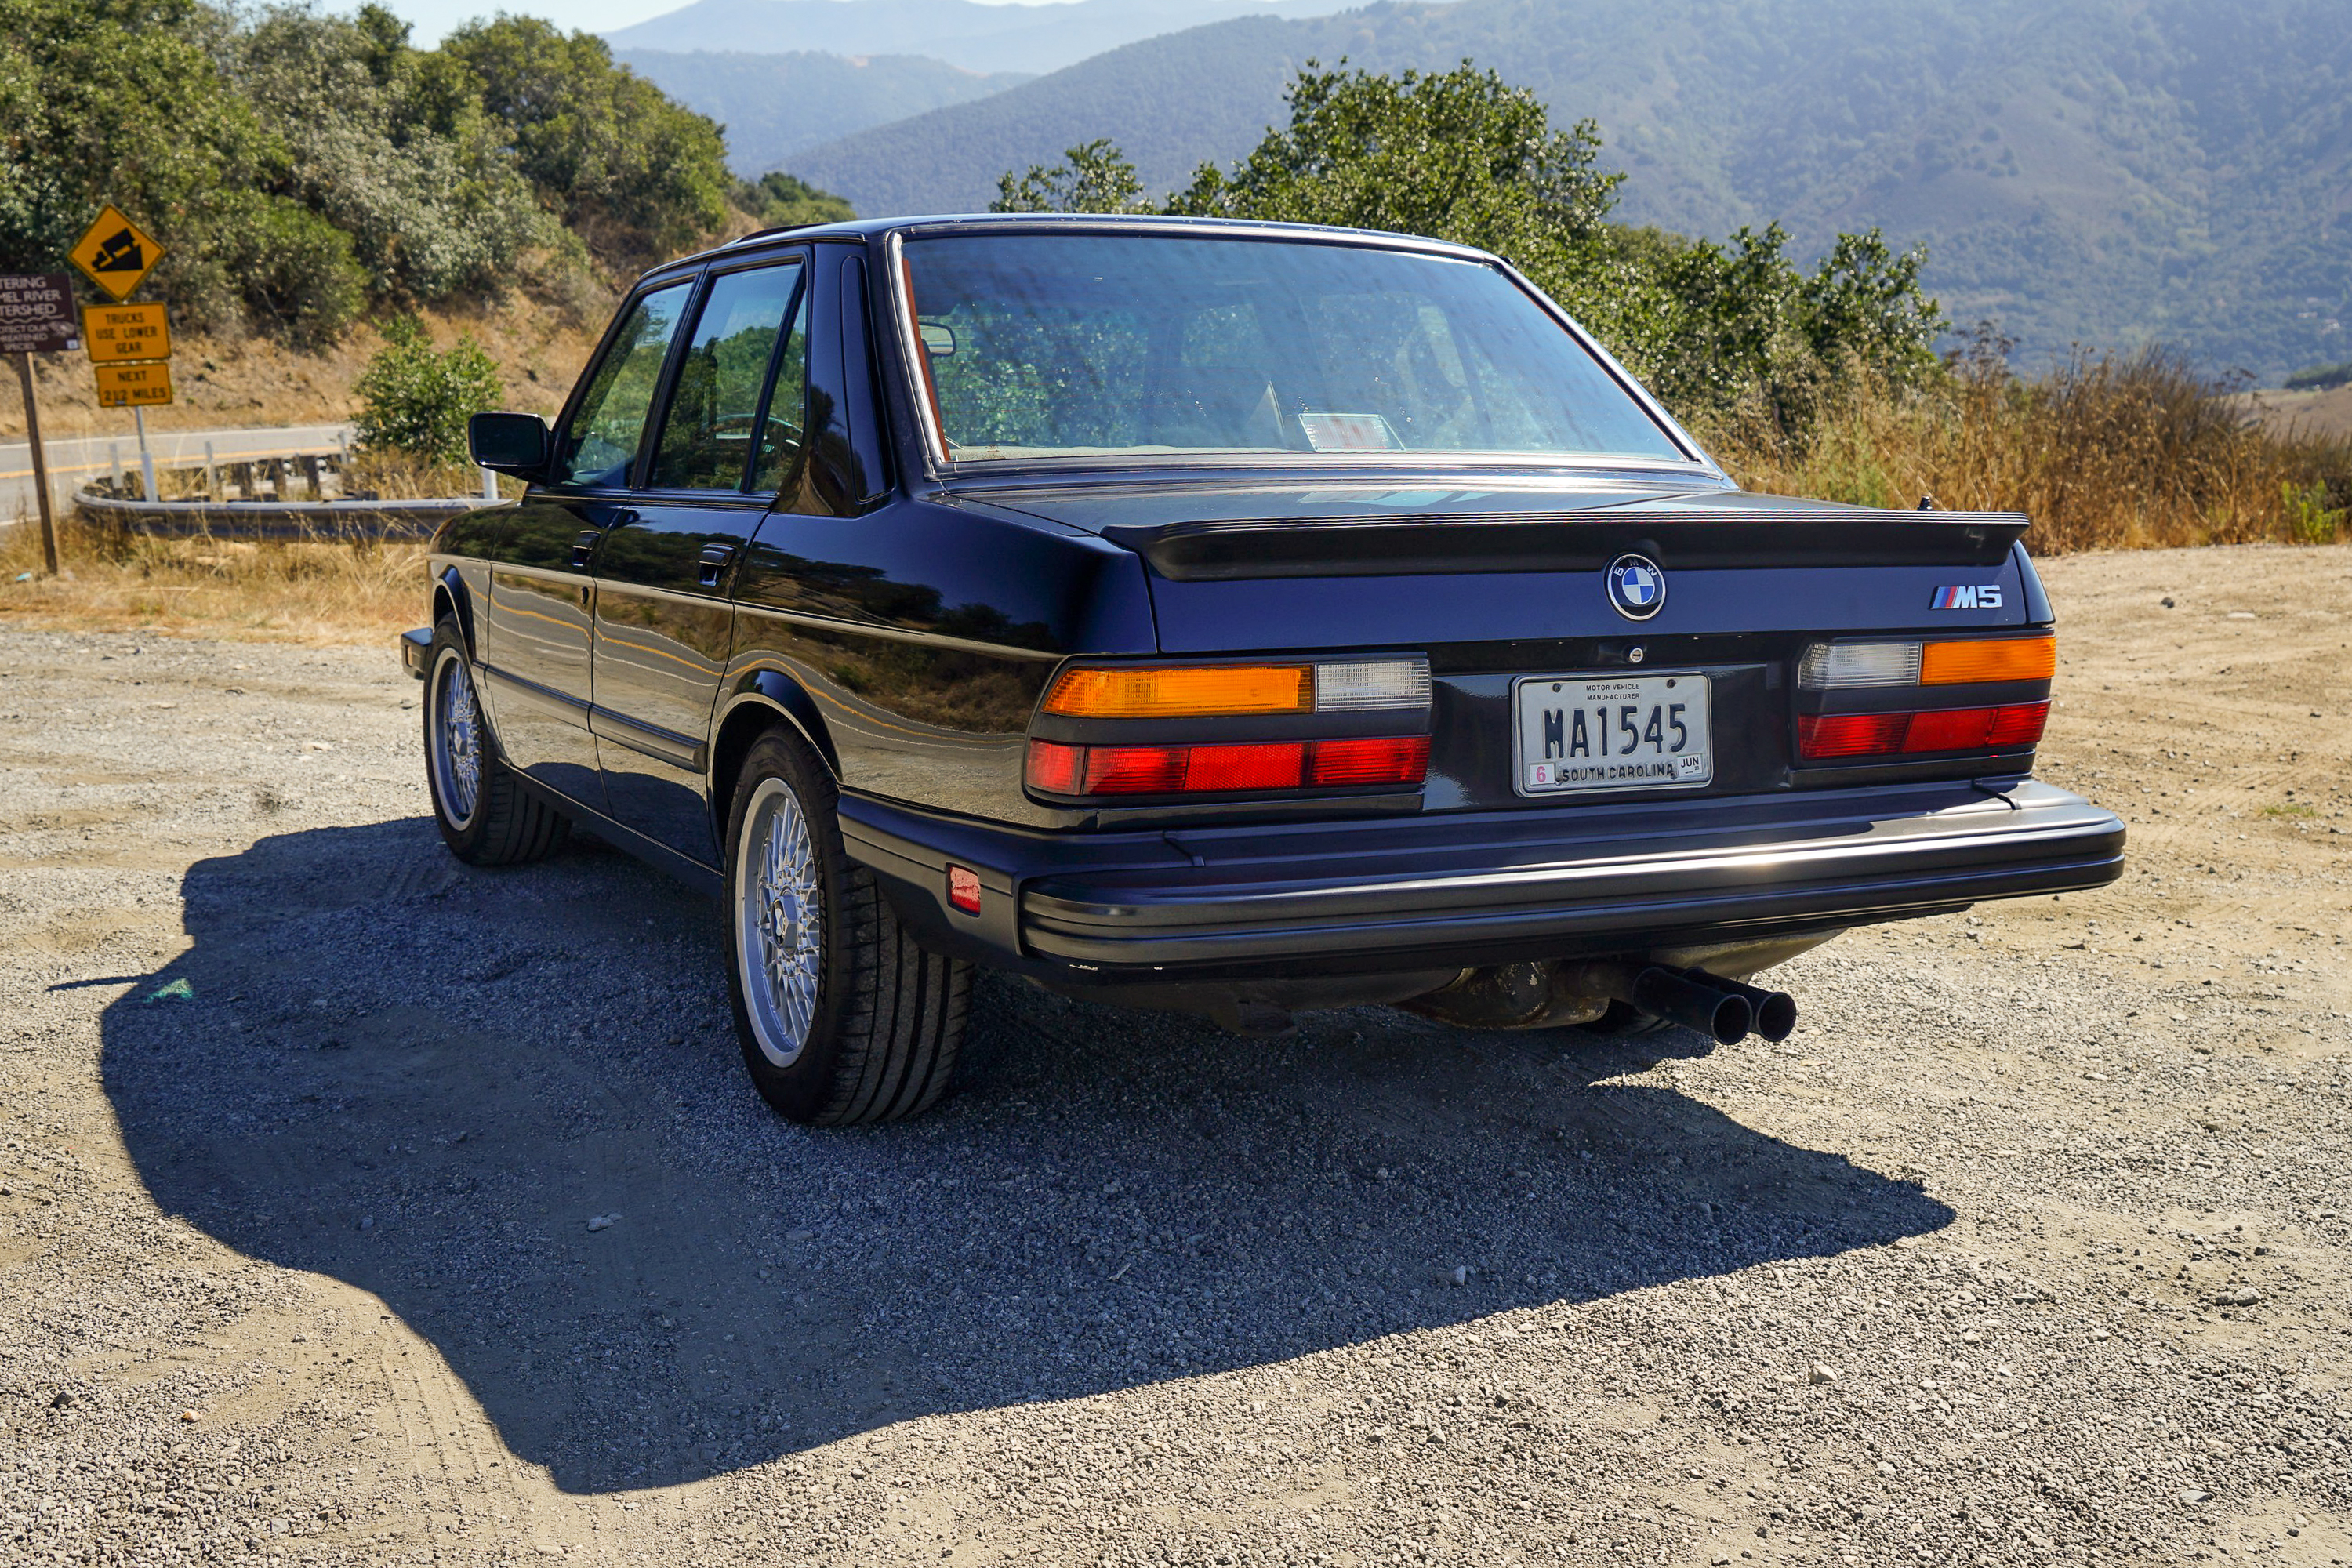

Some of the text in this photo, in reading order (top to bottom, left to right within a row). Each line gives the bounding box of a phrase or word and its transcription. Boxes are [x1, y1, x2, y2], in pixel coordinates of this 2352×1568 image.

[23, 289, 62, 302] RIVER
[105, 312, 144, 324] TRUCKS
[96, 326, 157, 339] USE LOWER
[115, 342, 142, 354] GEAR
[118, 371, 147, 382] NEXT
[132, 387, 166, 399] MILES
[1613, 558, 1657, 577] BMW
[1953, 585, 2003, 608] M5
[1543, 703, 1686, 759] MA1545
[1681, 757, 1699, 768] JUN
[1536, 766, 1546, 782] 6
[1562, 763, 1673, 782] SOUTH CAROLINA
